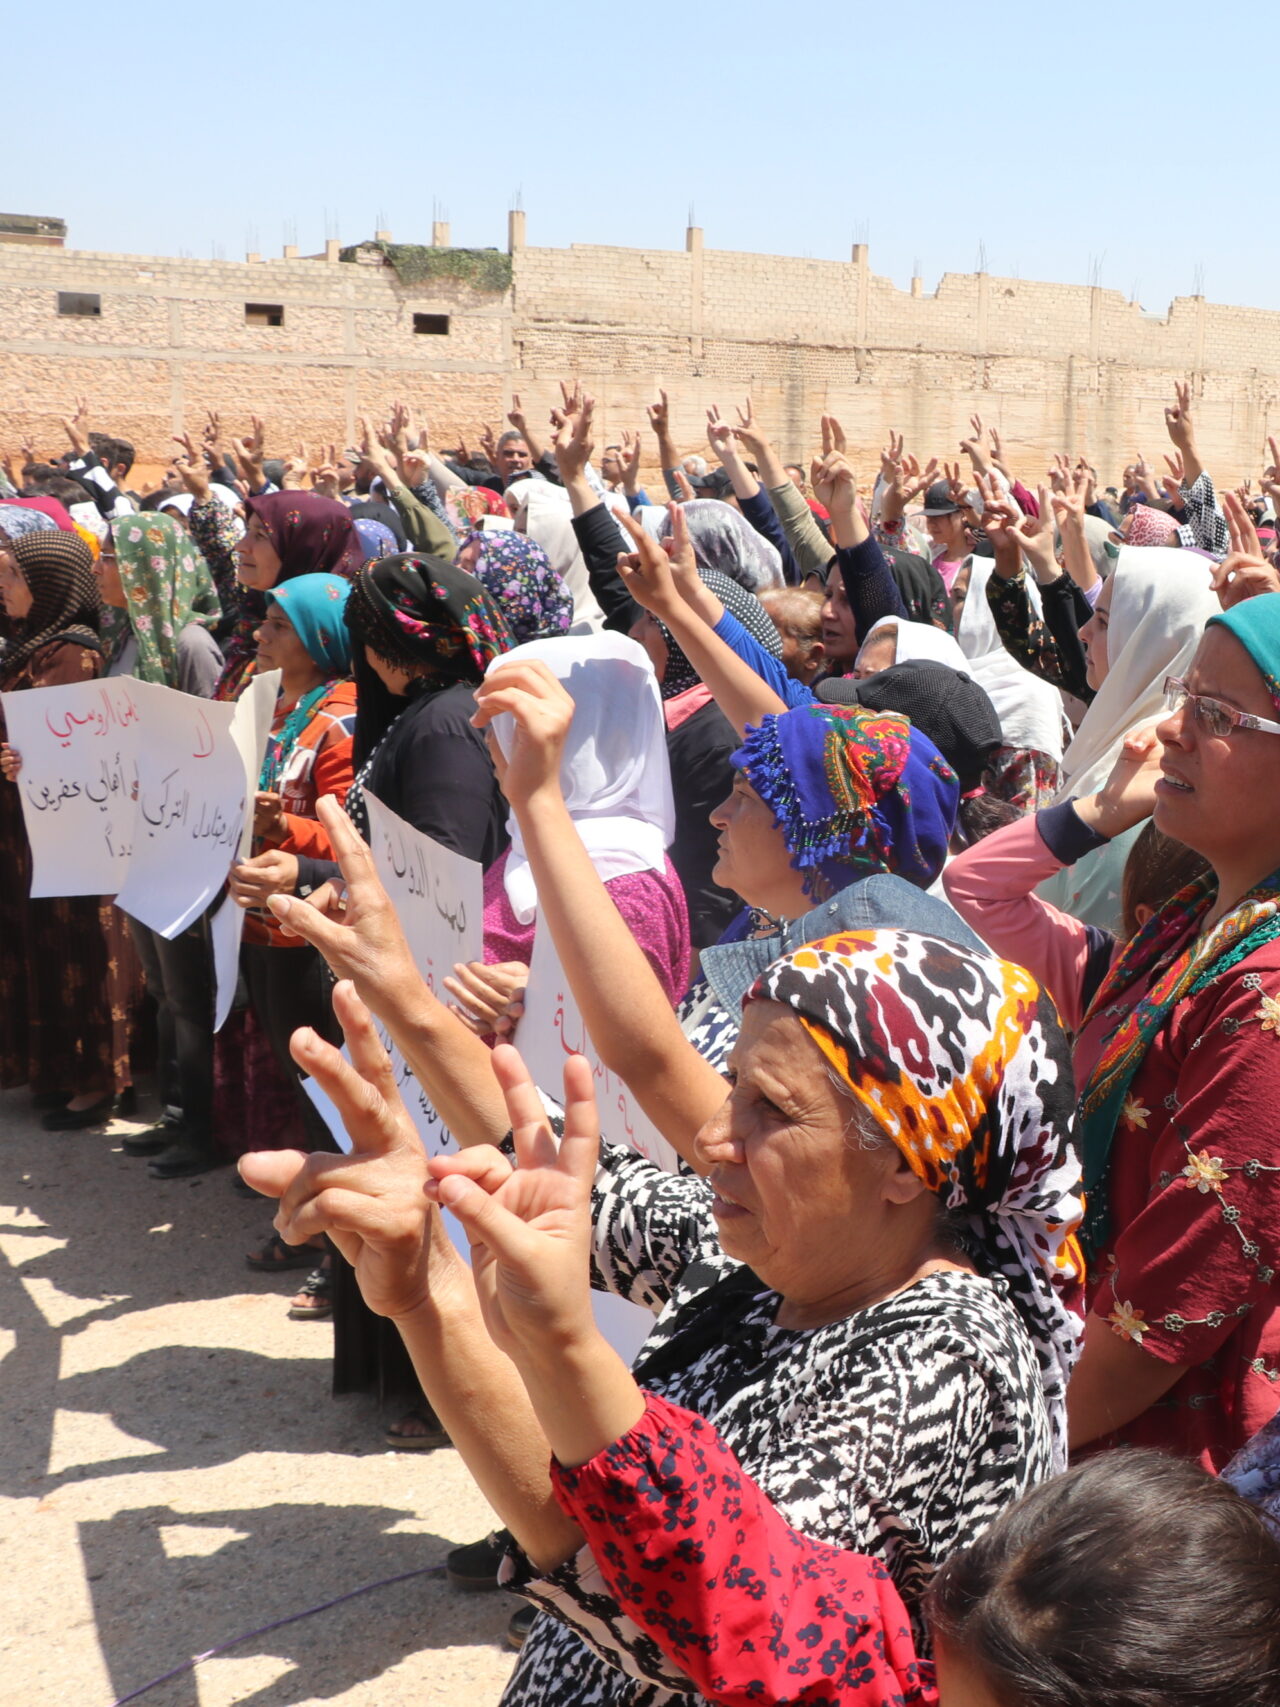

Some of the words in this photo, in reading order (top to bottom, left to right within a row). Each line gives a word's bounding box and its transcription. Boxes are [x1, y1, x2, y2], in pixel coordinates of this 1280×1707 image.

[45, 688, 116, 748] الروسي
[192, 708, 215, 758] لا
[27, 778, 82, 812] عفرين
